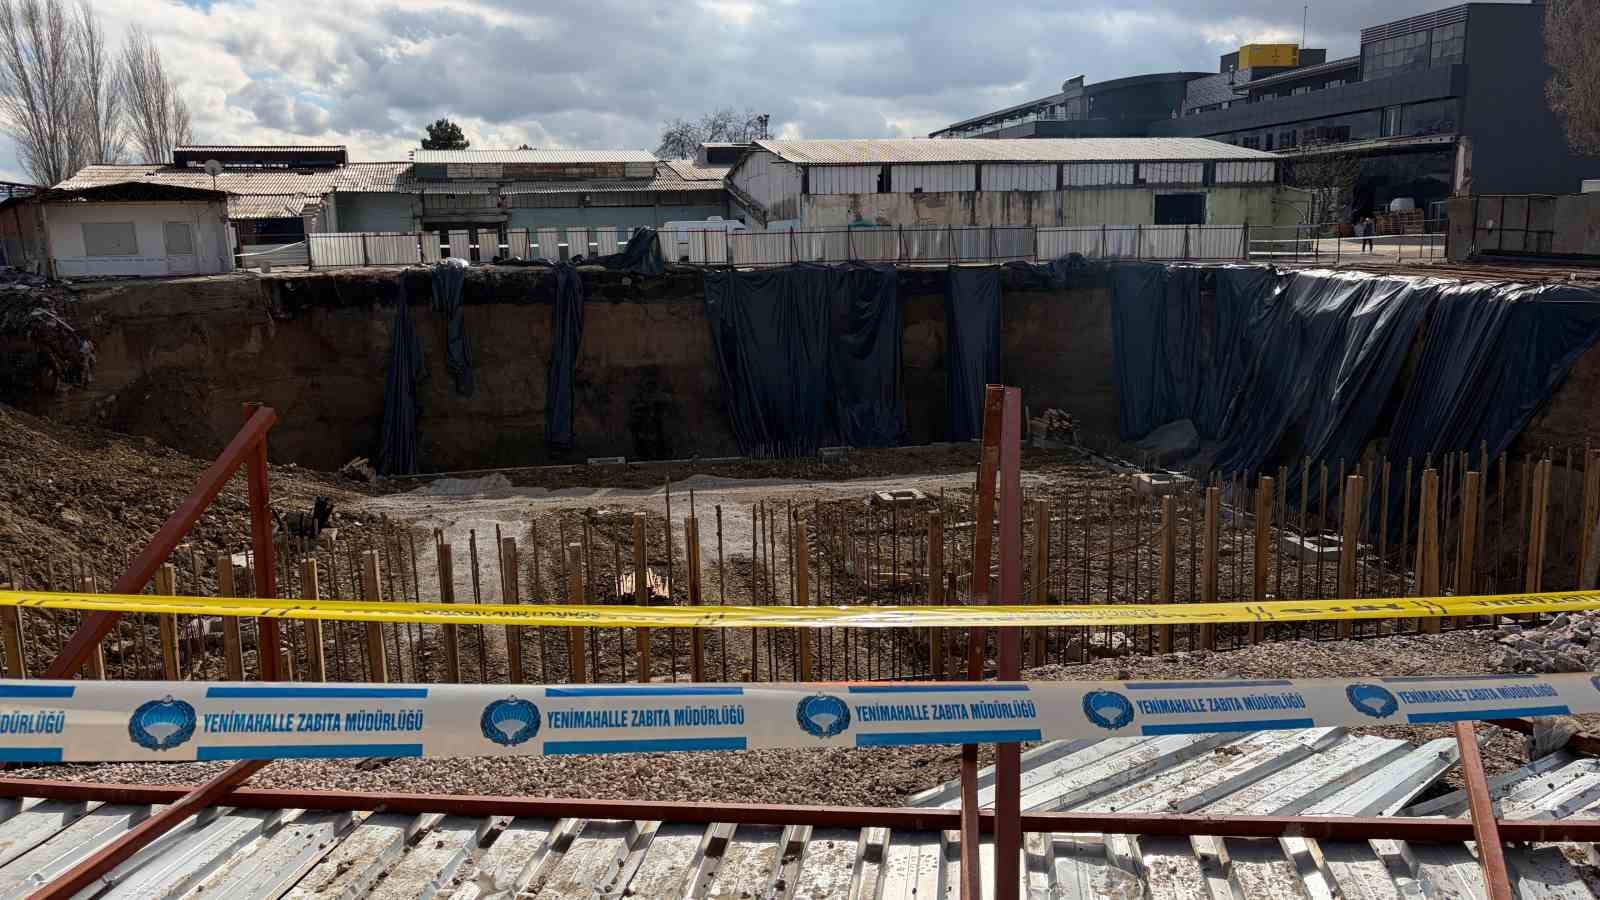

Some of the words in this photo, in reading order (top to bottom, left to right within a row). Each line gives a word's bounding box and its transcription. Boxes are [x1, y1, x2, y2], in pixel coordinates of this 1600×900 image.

[854, 702, 929, 723] YENİMAHALLE
[932, 703, 969, 721] ZABITA
[971, 700, 1037, 721] MÜDÜRLÜĞÜ
[1136, 696, 1206, 715] YENİMAHALLE
[1206, 696, 1241, 713] ZABITA
[1243, 693, 1306, 712] MÜDÜRLÜĞÜ
[203, 711, 294, 734] YENİMAHALLE
[297, 712, 341, 733] ZABITA
[346, 709, 425, 732] MÜDÜRLÜĞÜ
[548, 707, 628, 729] YENİMAHALLE
[631, 710, 671, 728] ZABITA
[674, 706, 745, 727] MÜDÜRLÜĞÜ
